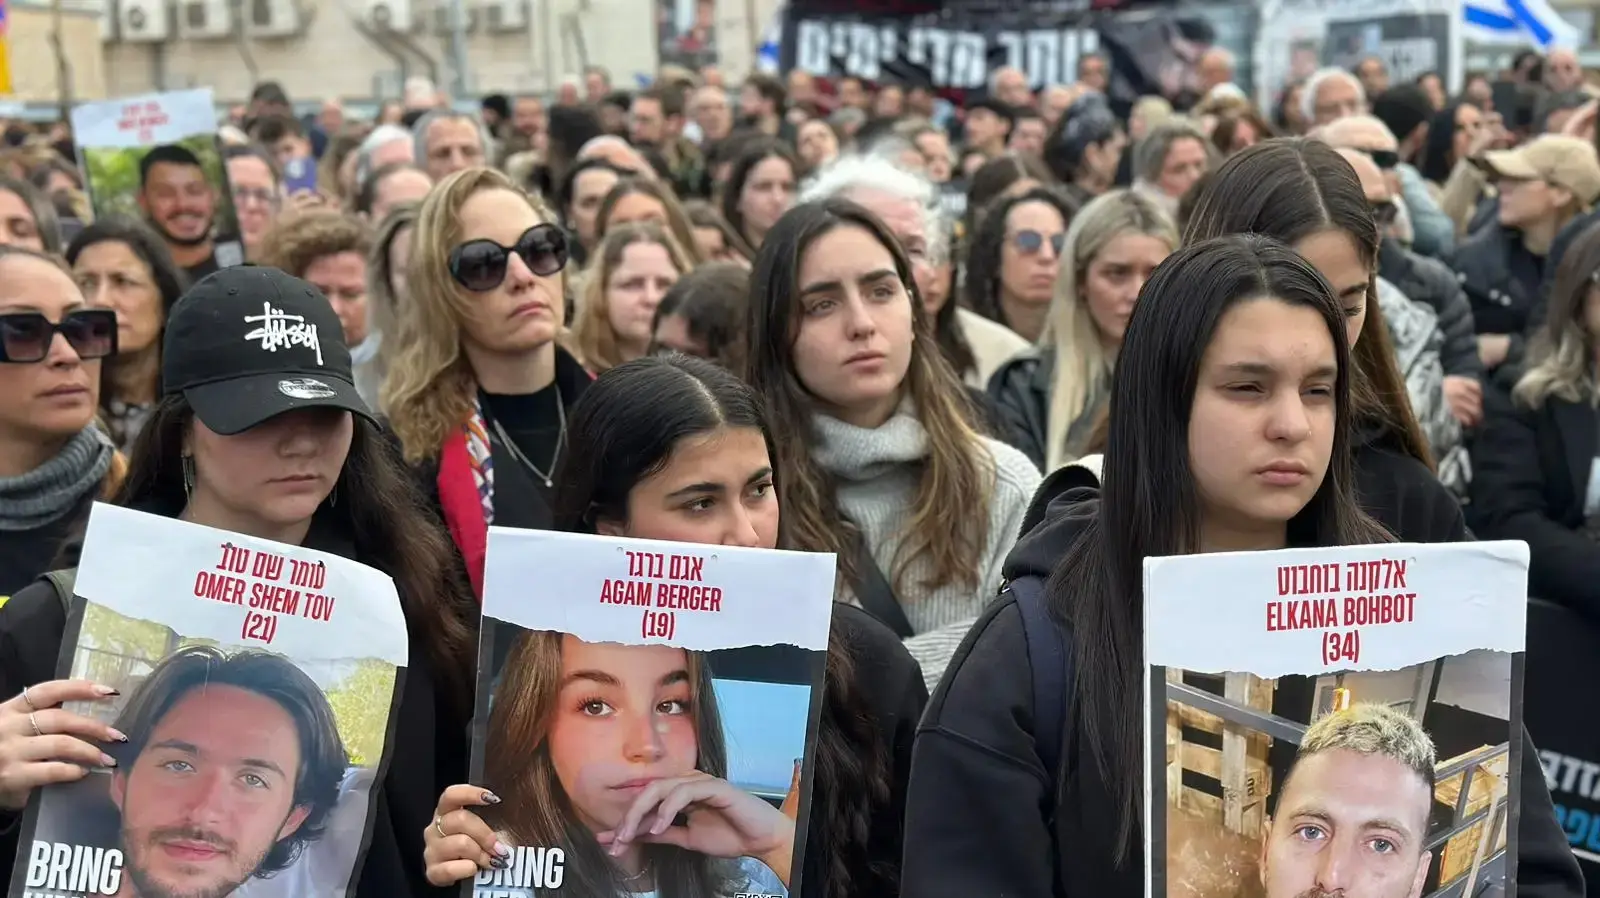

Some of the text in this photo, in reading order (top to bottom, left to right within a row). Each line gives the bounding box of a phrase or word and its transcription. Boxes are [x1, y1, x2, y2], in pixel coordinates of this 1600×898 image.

[797, 20, 898, 79] ימים
[907, 26, 987, 89] מדי
[216, 543, 326, 589] עומר שם טוב
[626, 551, 704, 581] אגם ברגר
[1278, 558, 1407, 596] אלקנה בוחבוט
[194, 571, 335, 621] OMER SHEM TOV
[600, 579, 722, 612] AGAM BERGER
[1266, 593, 1417, 631] ELKANA BOHBOT
[242, 611, 277, 644] (21)
[642, 610, 675, 640] (19)
[1322, 629, 1360, 665] (34)
[25, 839, 124, 895] BRING
